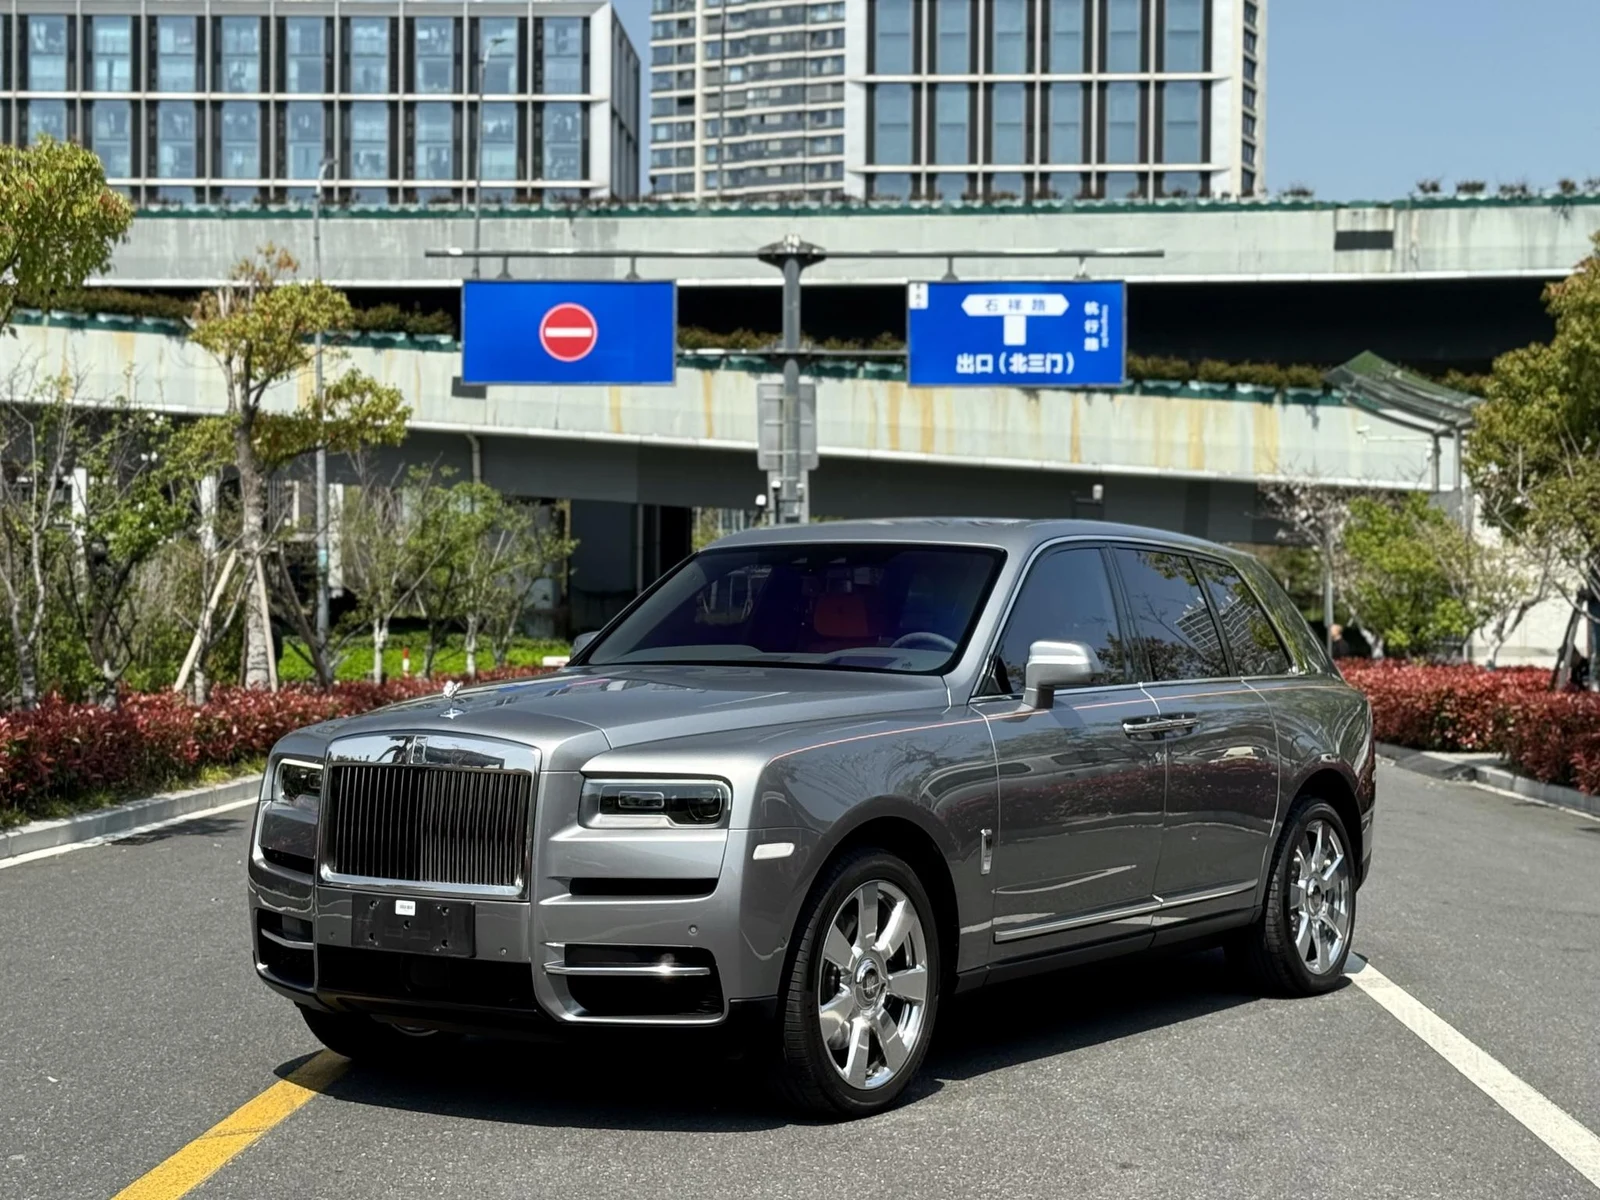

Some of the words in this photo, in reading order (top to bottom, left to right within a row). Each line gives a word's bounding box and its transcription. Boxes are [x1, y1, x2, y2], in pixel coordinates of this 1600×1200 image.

[956, 352, 1075, 375] 出口(北三门)
